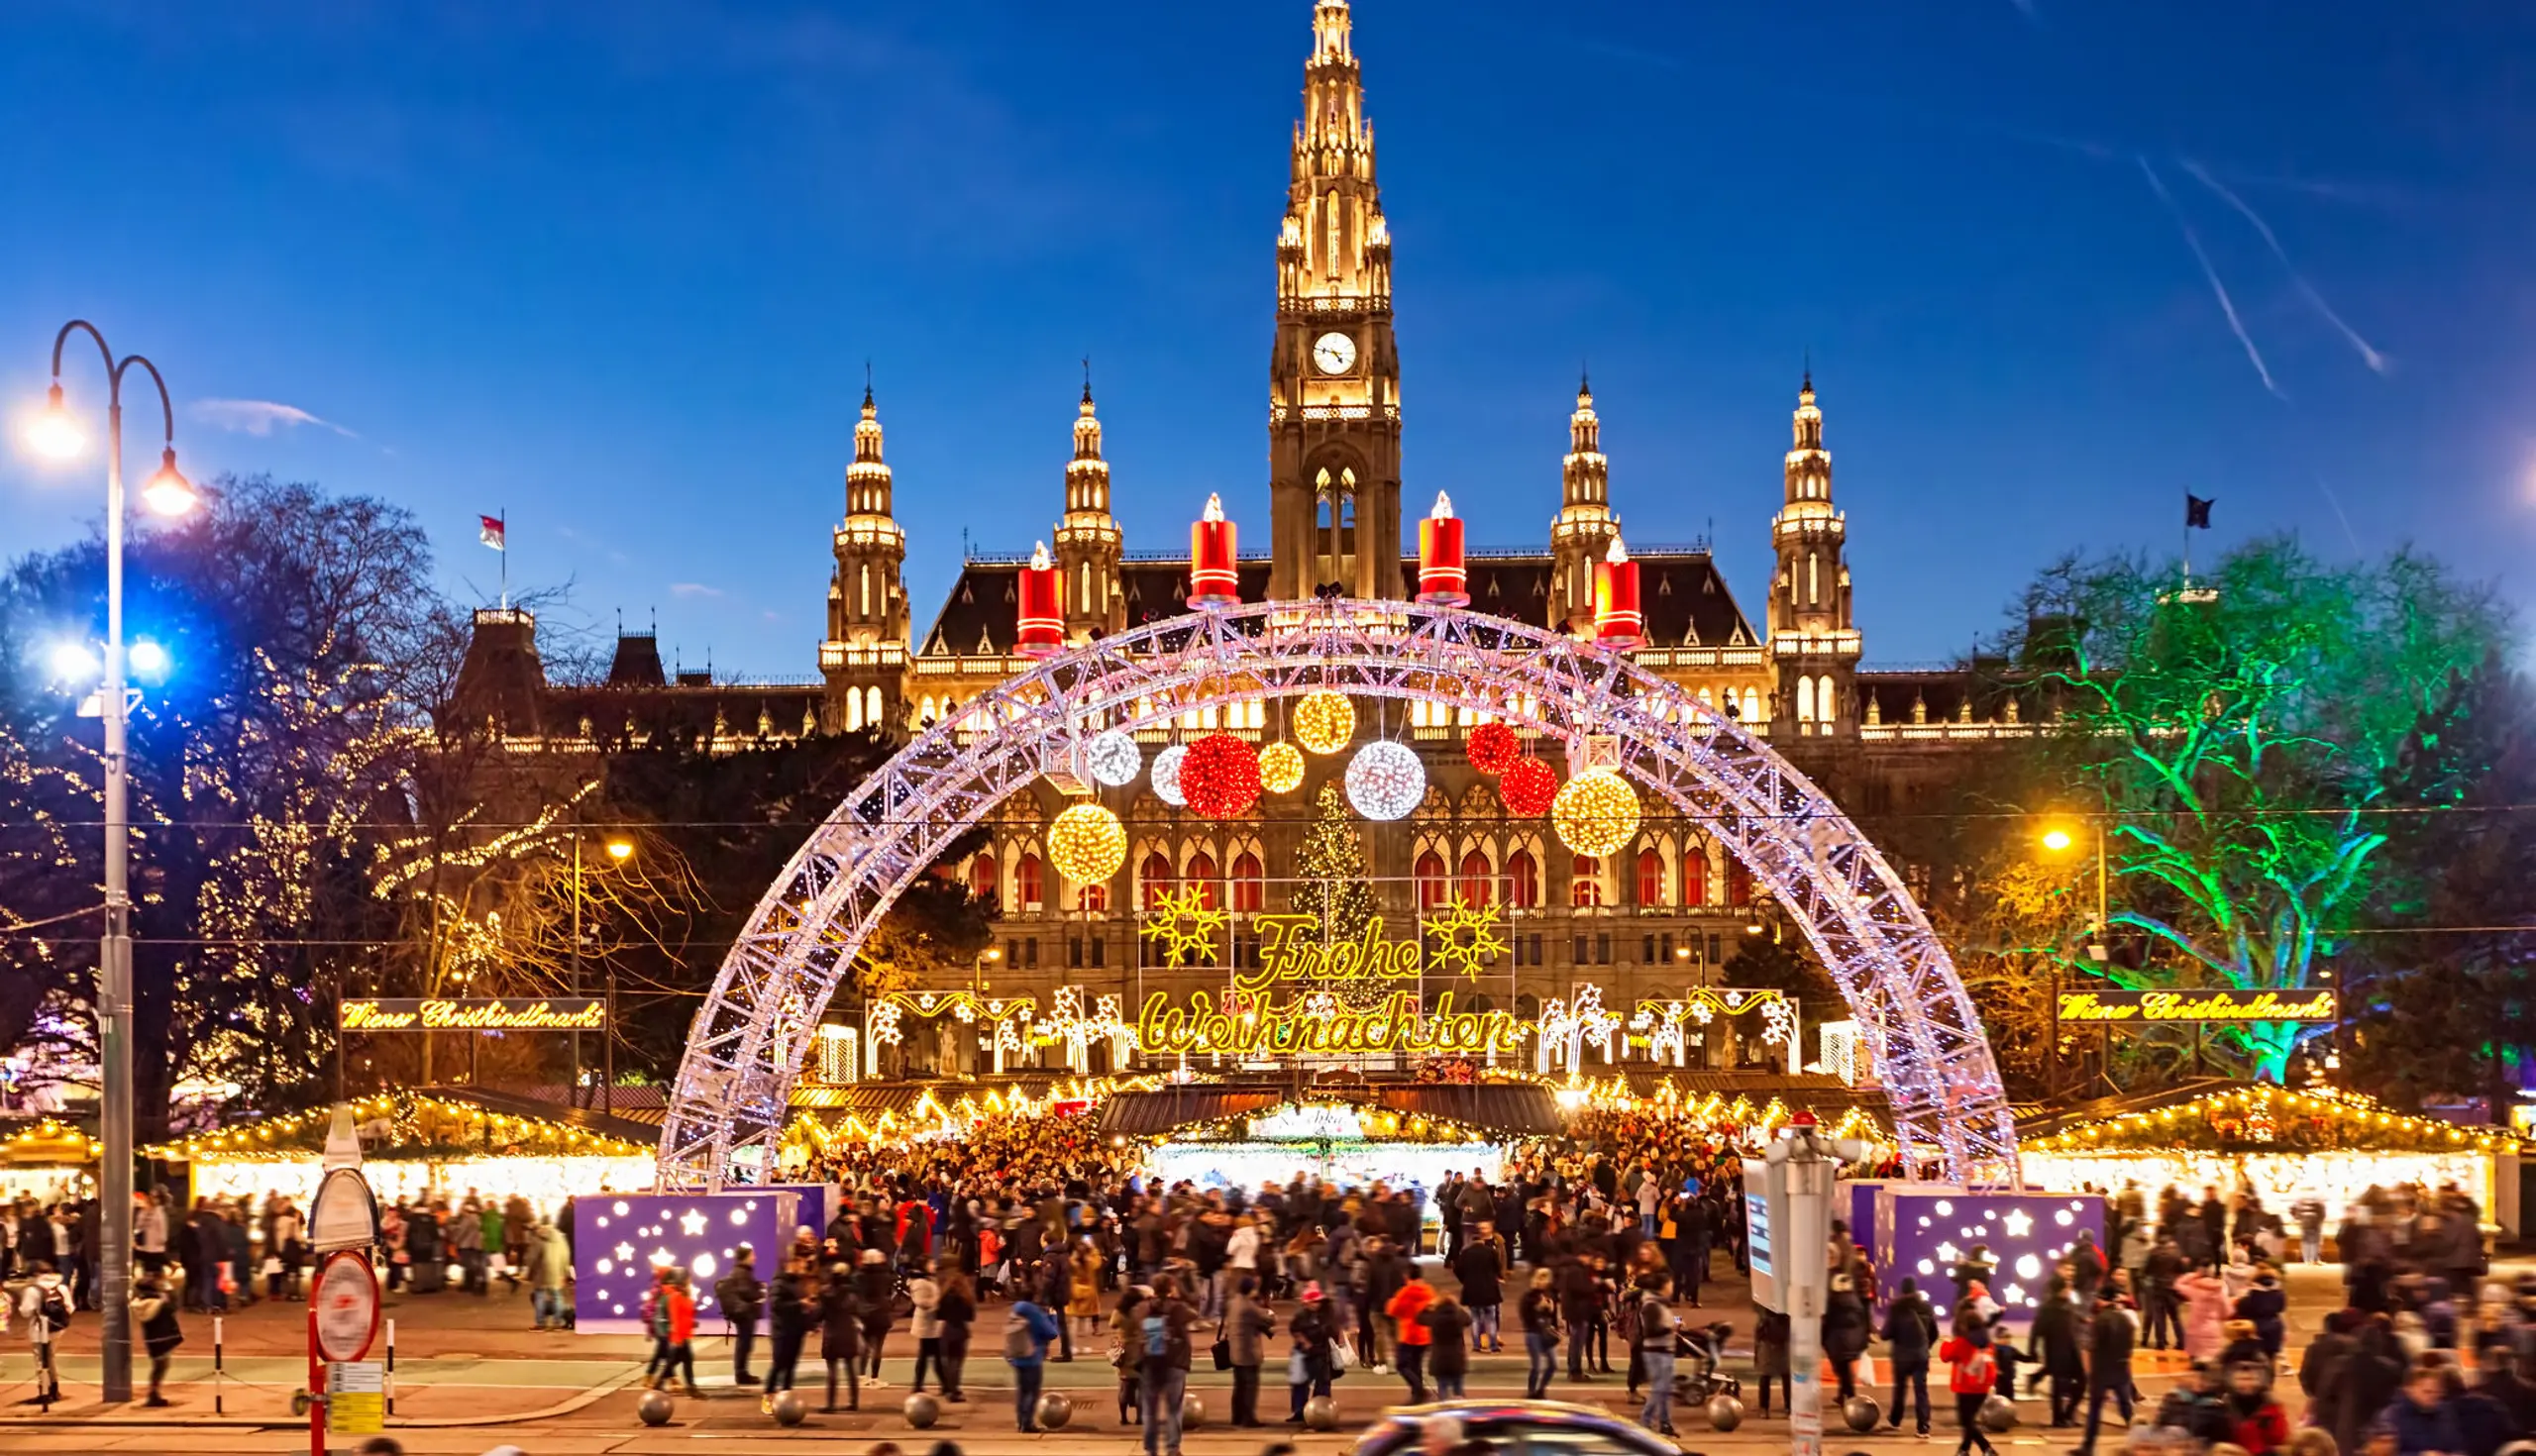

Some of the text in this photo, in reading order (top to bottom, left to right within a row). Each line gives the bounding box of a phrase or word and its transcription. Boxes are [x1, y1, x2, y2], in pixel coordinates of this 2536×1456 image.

[1234, 915, 1424, 991] Frohe
[341, 999, 605, 1028] Wiener Christkindlmarkt
[1139, 990, 1518, 1054] Weihnachten
[2059, 991, 2336, 1020] Wiener Christkindlmarkt
